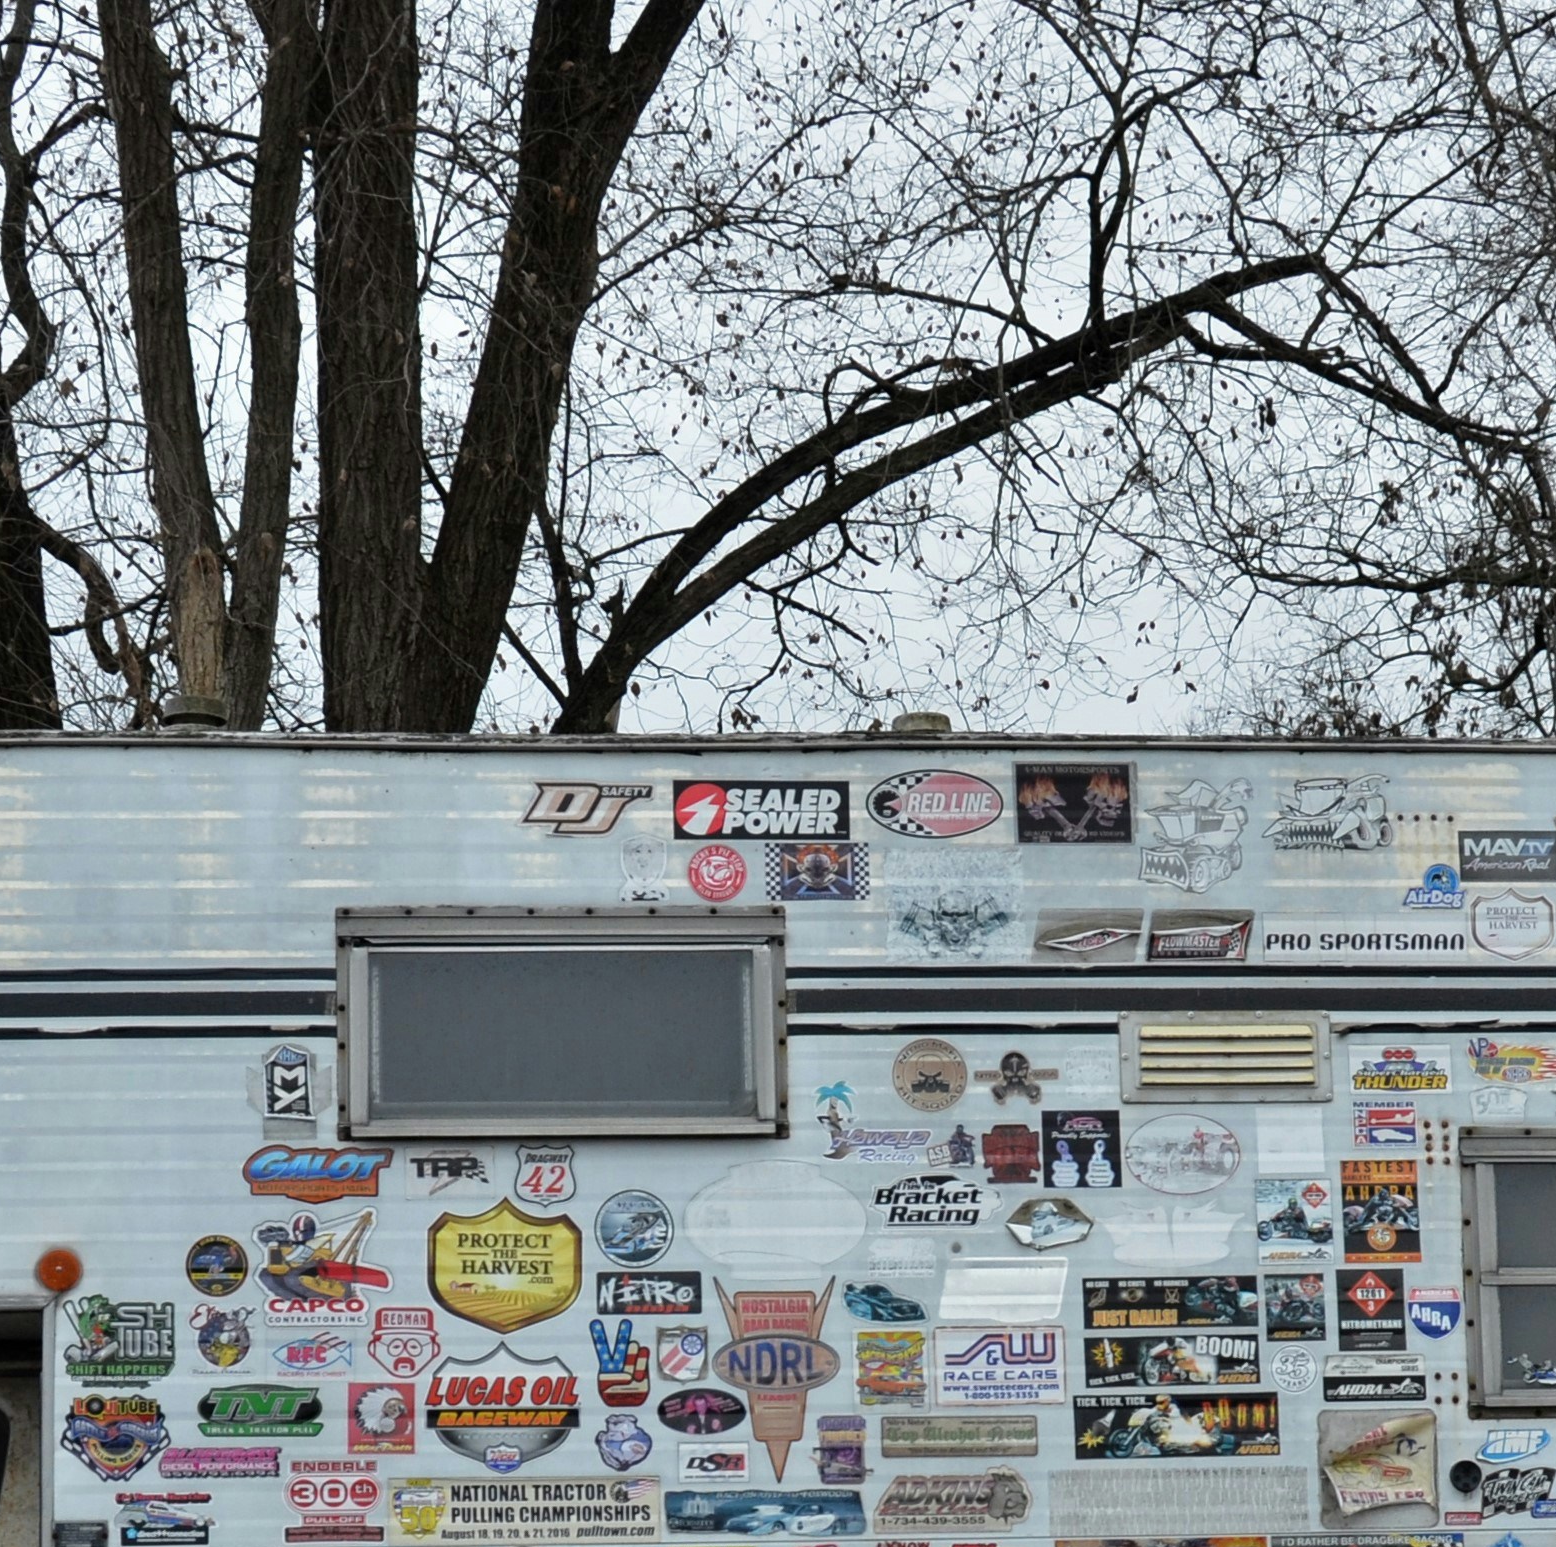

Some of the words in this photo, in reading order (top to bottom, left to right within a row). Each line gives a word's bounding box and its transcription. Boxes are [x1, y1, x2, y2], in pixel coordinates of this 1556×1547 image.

[601, 786, 650, 797] SAFETY
[725, 788, 841, 812] SEALED
[721, 812, 837, 835] POWER
[1266, 934, 1311, 951] PRO
[1320, 934, 1464, 951] SPORTSMAN
[1353, 1075, 1448, 1090] THUNDER
[249, 1150, 387, 1181] GALOT
[410, 1157, 478, 1178] TRP
[521, 1165, 566, 1194] 42
[875, 1187, 983, 1205] Bracket
[888, 1206, 980, 1225] Racing
[457, 1233, 552, 1249] PROTECT
[492, 1250, 518, 1259] THE
[461, 1260, 553, 1275] HARVEST
[527, 1275, 554, 1285] .com
[268, 1299, 365, 1313] CAPCO
[113, 1303, 174, 1328] SH
[268, 1316, 342, 1324] CONTRACTORS
[345, 1315, 366, 1324] INC.
[381, 1312, 428, 1326] REDMAN
[1340, 1319, 1403, 1330] NITROMETHANE
[117, 1328, 174, 1361] TUBE
[1195, 1336, 1256, 1360] BOOM!
[66, 1364, 103, 1376] SHIFT
[106, 1364, 166, 1376] HAPPENS
[425, 1376, 527, 1406] LUCAS
[531, 1376, 579, 1405] OIL
[210, 1389, 314, 1420] TNT
[436, 1411, 569, 1427] RACEWAY
[292, 1461, 377, 1472] ENDERLE
[293, 1482, 346, 1504] 30
[450, 1484, 528, 1502] NATIONAL
[532, 1483, 607, 1501] TRACTOR
[451, 1506, 515, 1524] PULLING
[519, 1504, 651, 1523] CHAMPIONSHIPS
[880, 1516, 986, 1526] 1-734-439-3555
[441, 1529, 476, 1541] August
[549, 1528, 570, 1538] 2016
[576, 1525, 655, 1538] pulltown.com
[1281, 1537, 1295, 1546] I'D
[1297, 1536, 1338, 1546] RATHER
[1341, 1536, 1355, 1545] BE
[1358, 1535, 1411, 1545] DRAGBIKE
[1413, 1535, 1453, 1545] RACING
